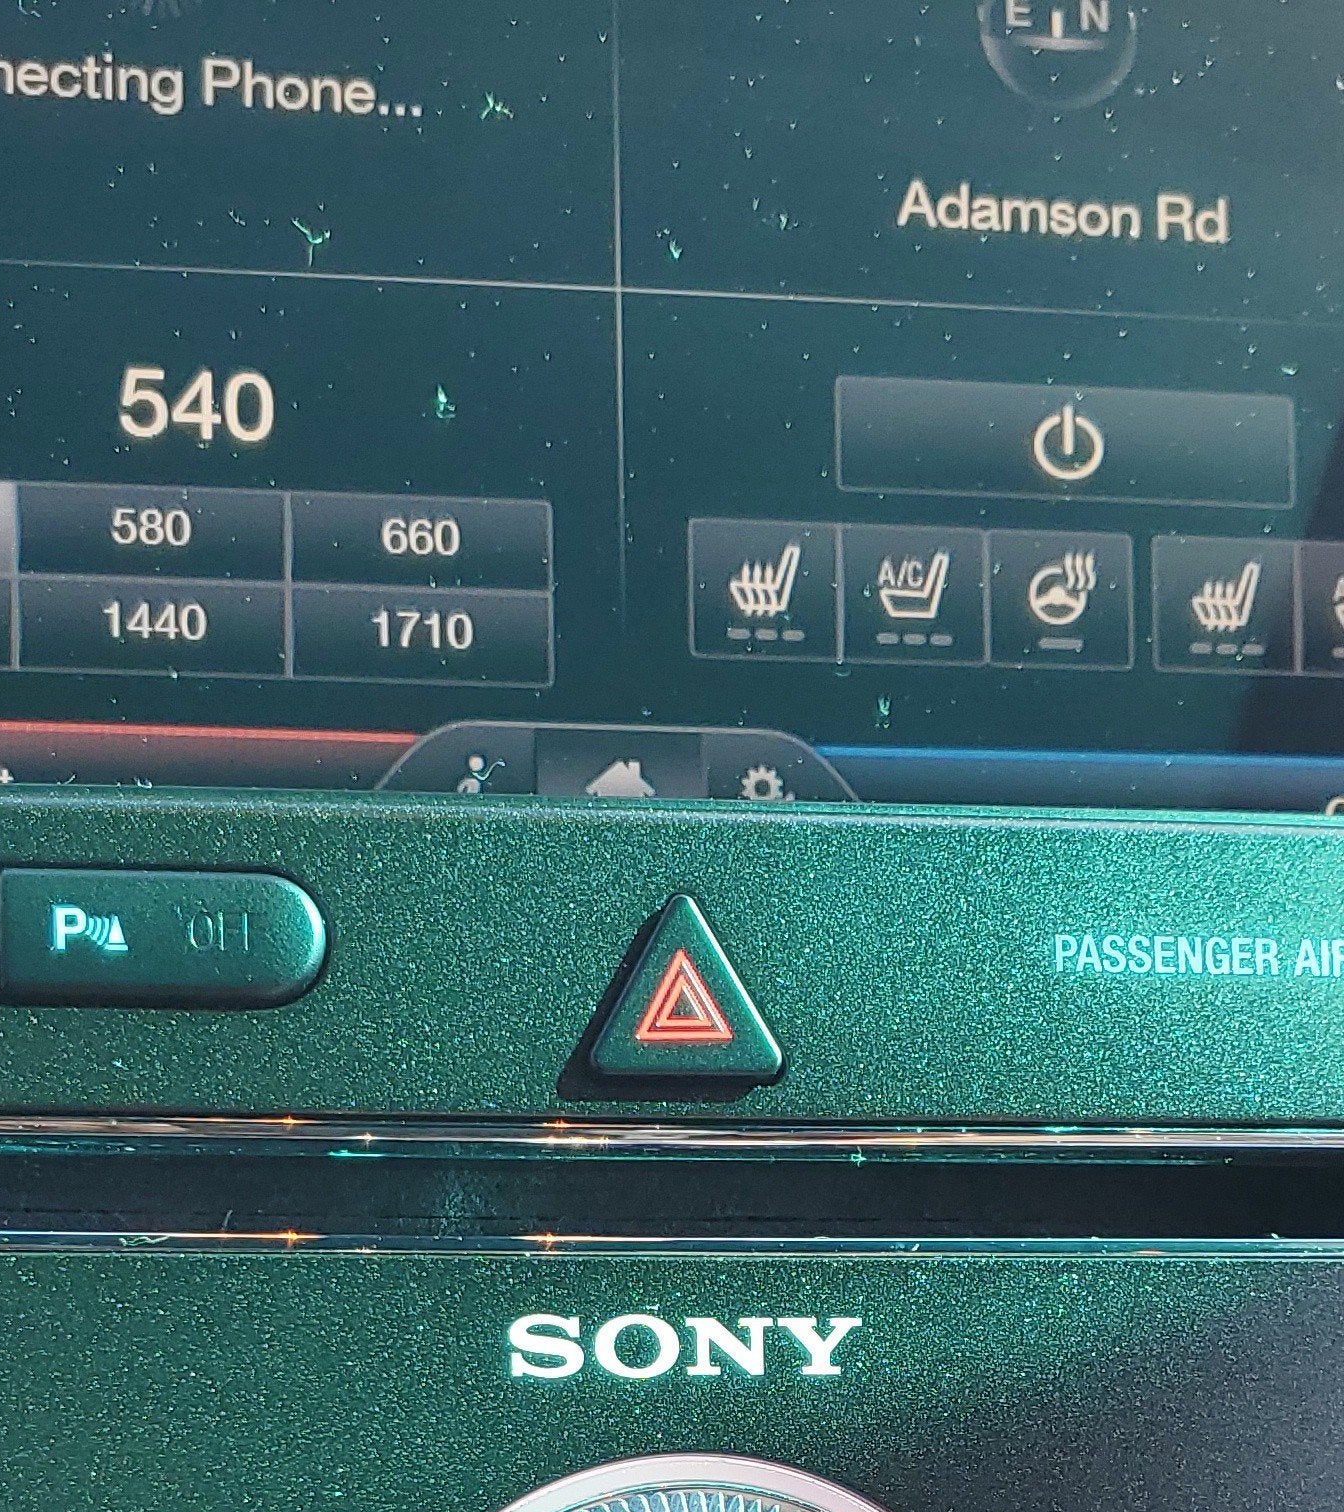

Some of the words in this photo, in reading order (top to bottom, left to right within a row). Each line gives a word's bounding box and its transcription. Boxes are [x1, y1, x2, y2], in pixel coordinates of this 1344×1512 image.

[1005, 0, 1034, 28] E
[1079, 0, 1109, 33] N
[896, 178, 1141, 240] Adamson
[1156, 194, 1229, 244] Rd
[118, 366, 274, 442] 540
[110, 508, 193, 547] 580
[380, 518, 462, 557] 660
[877, 558, 925, 588] A/C
[103, 602, 207, 642] 1440
[372, 612, 475, 651] 1710
[55, 906, 87, 952] P
[1056, 935, 1279, 976] PASSENGER
[508, 1313, 862, 1379] SONY
